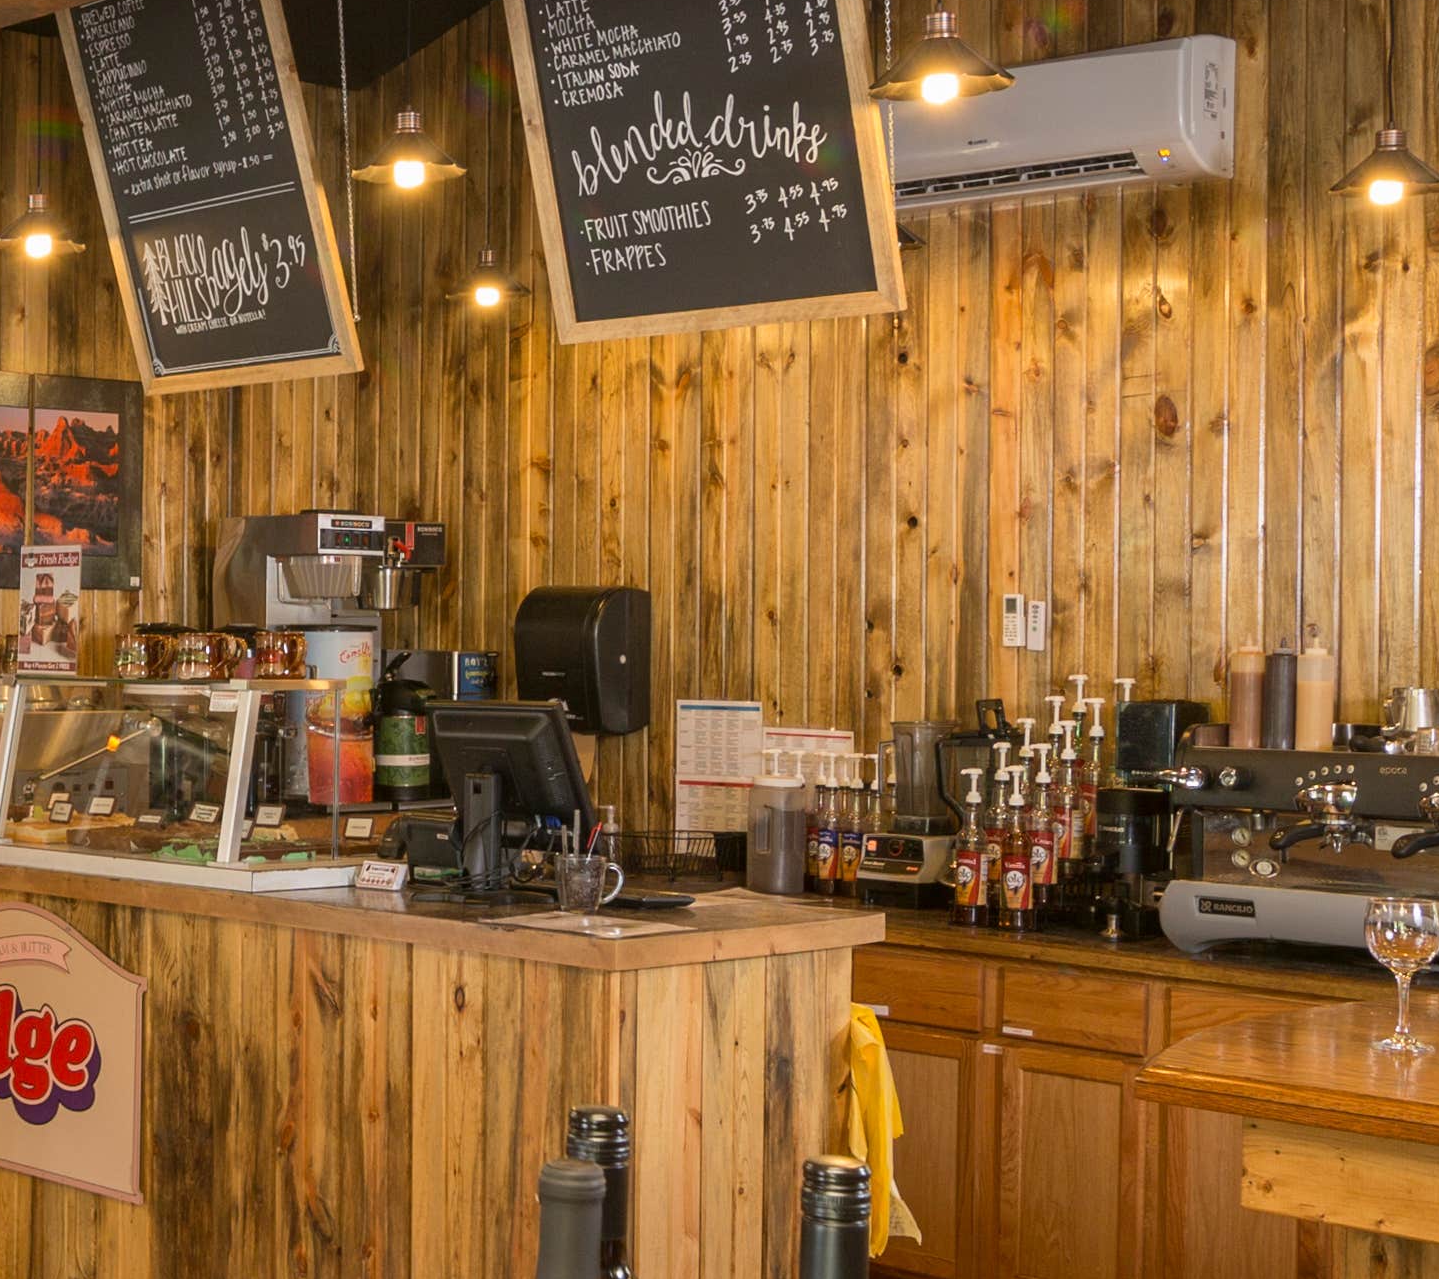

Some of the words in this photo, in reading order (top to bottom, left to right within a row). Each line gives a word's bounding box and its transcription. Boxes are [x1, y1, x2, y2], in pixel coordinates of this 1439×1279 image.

[86, 16, 135, 41] AMERICANO
[547, 13, 596, 39] MOCHA
[88, 33, 131, 57] ESPRESSO
[551, 32, 592, 56] WHITE
[596, 25, 638, 46] MOCHA
[553, 45, 610, 71] CARAMEL
[612, 32, 681, 59] MACCHIATO
[92, 52, 121, 72] LATTE
[558, 67, 604, 90] ITALIAN
[607, 61, 640, 79] SODA
[99, 82, 132, 99] MOCHA
[101, 94, 132, 113] WHITE
[133, 85, 165, 104] MOCHA
[561, 80, 624, 107] CREMOSA
[106, 107, 142, 127] CARAMEL
[142, 94, 192, 117] MACCHIATO
[109, 126, 130, 142] CHAI
[130, 121, 151, 136] TEA
[151, 114, 178, 132] LATTE
[112, 142, 130, 158] HOT
[131, 138, 153, 156] TEA
[571, 90, 702, 197] blended
[705, 93, 827, 163] drinks
[116, 158, 135, 175] HOT
[137, 147, 188, 170] CHOCOLATE
[584, 214, 629, 242] FRUIT
[632, 201, 711, 235] SMOOTHIES
[155, 233, 207, 278] BLACK
[261, 233, 305, 289] $3.95
[590, 243, 667, 275] FRAPPES
[163, 277, 212, 324] HILLS
[39, 554, 57, 565] Fresh
[58, 553, 78, 566] Fudge
[1212, 903, 1255, 914] RANCILIO
[21, 941, 52, 955] BUTTER
